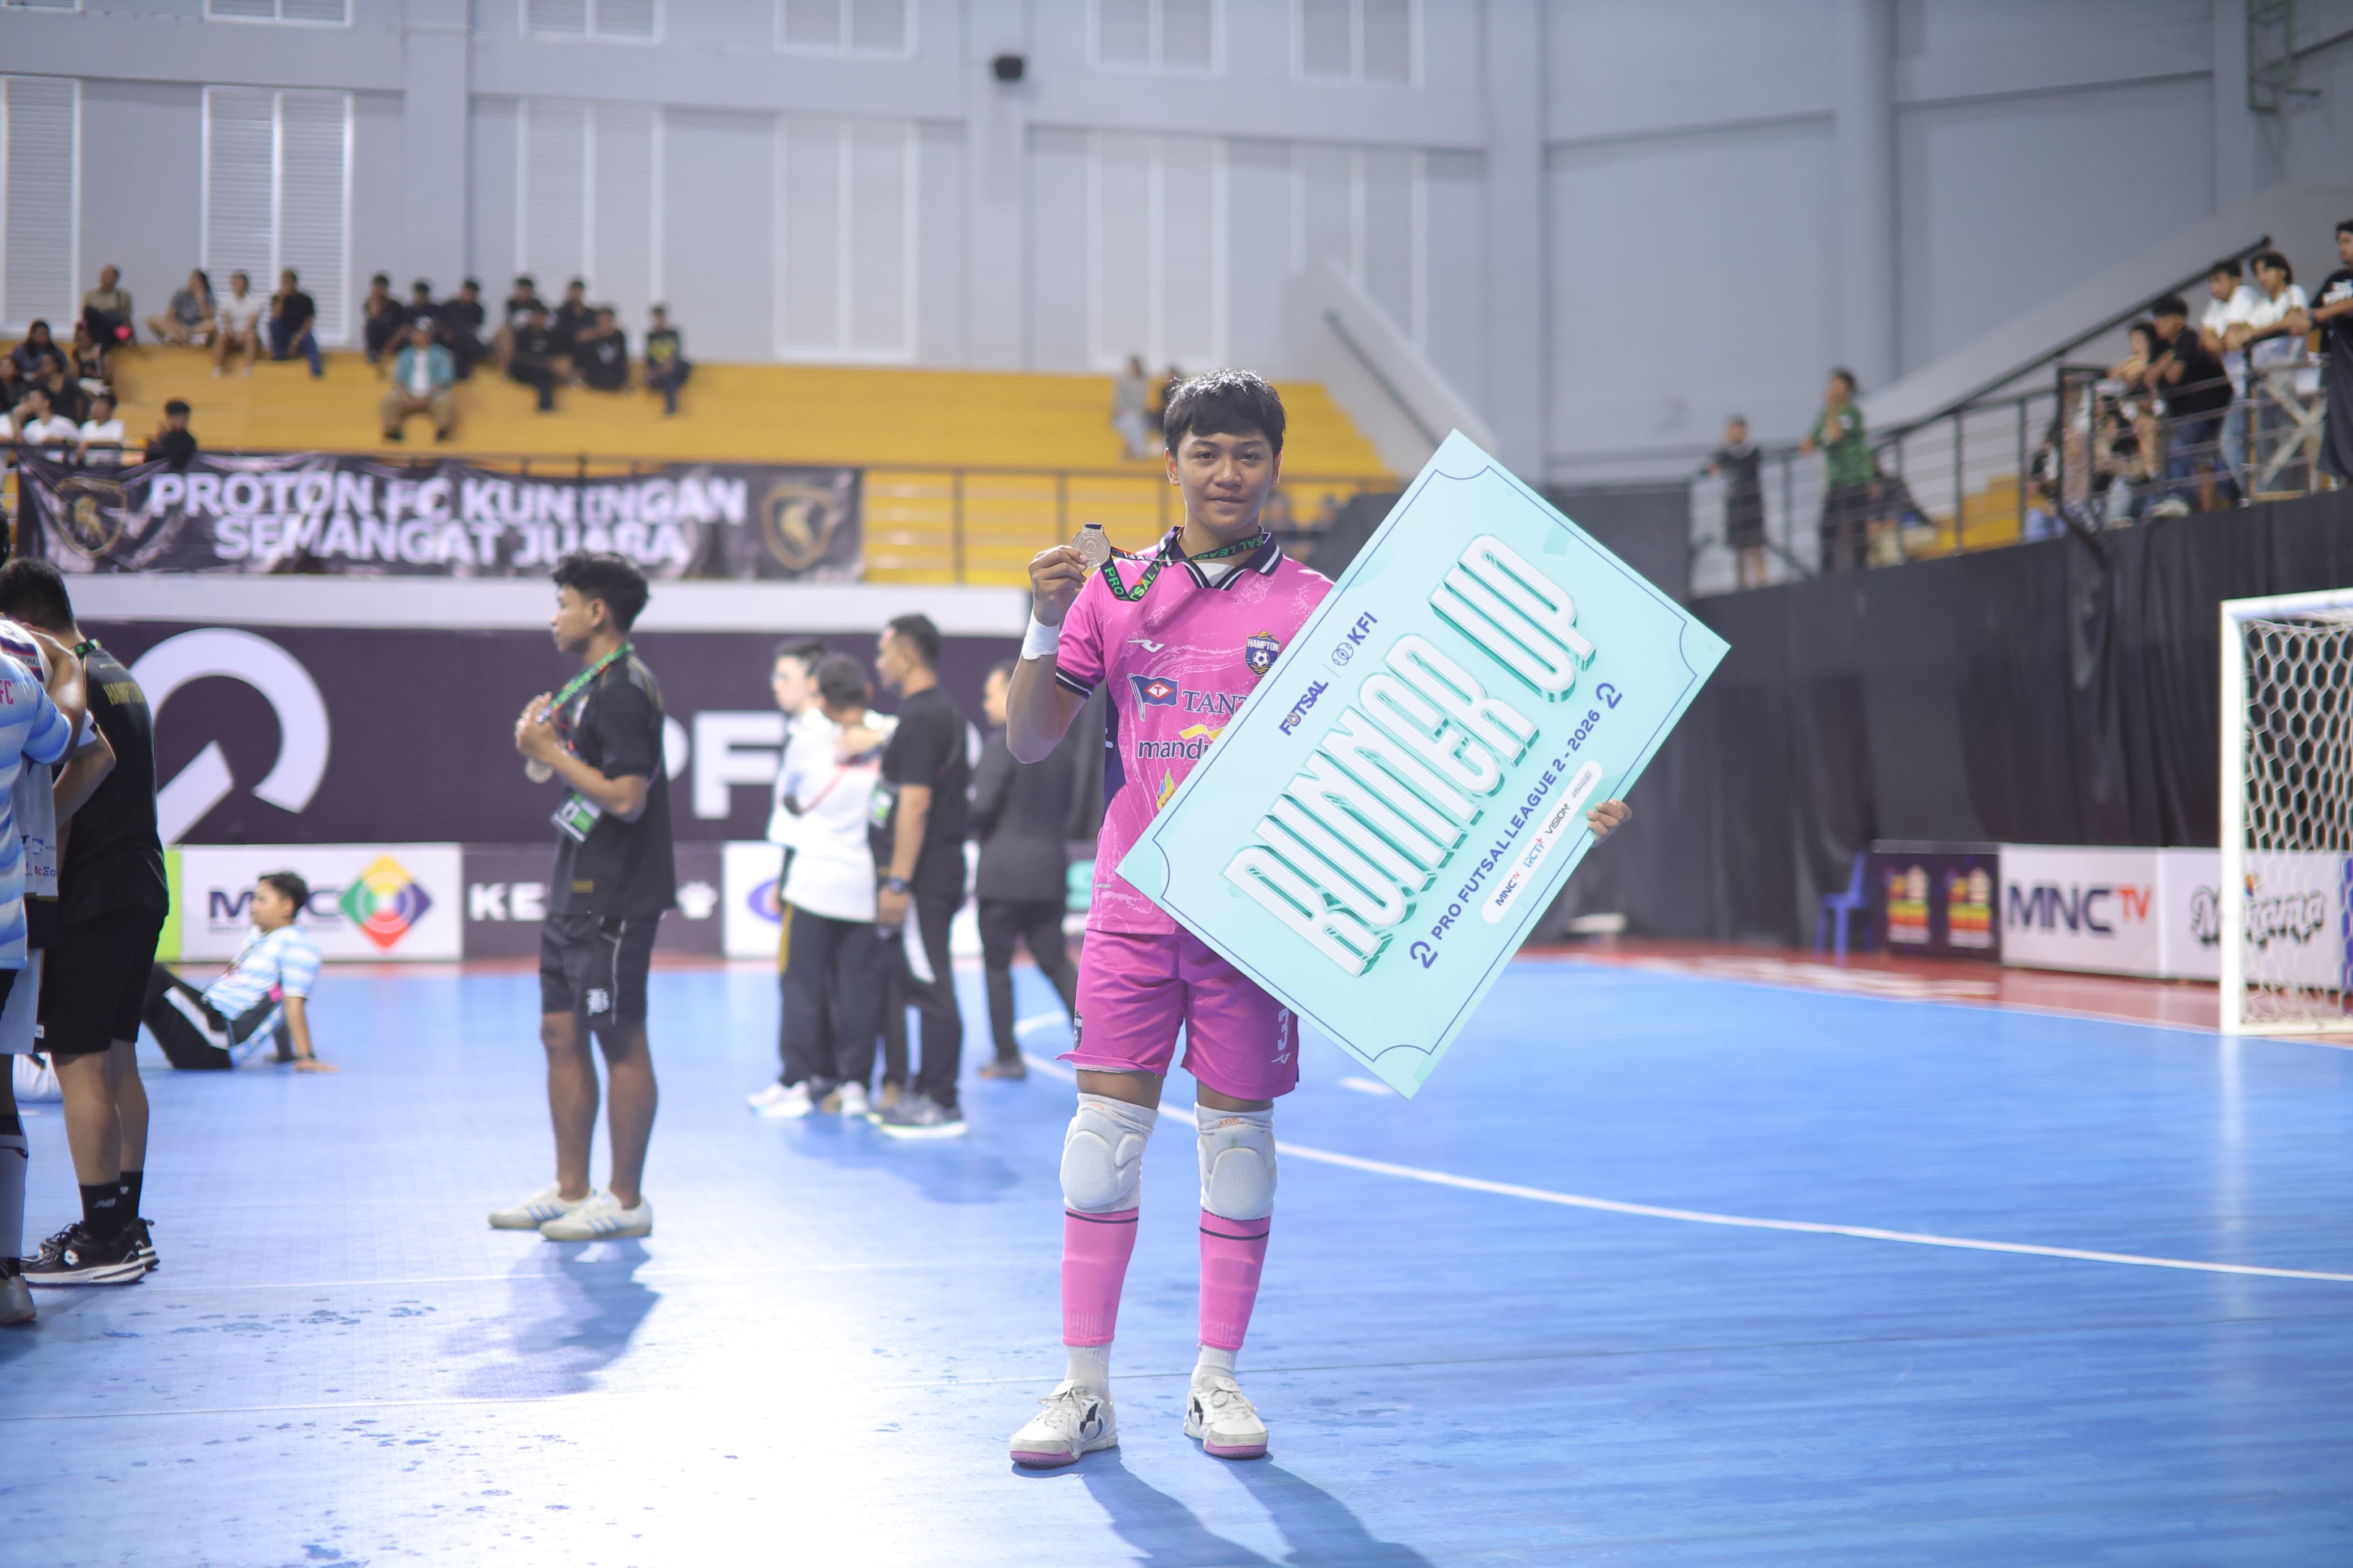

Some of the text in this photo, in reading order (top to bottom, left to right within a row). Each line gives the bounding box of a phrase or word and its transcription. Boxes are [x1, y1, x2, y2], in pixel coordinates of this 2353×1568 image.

[150, 470, 373, 518] PROTON
[385, 477, 455, 522] FC
[214, 515, 504, 566] SEMANGAT
[1104, 567, 1124, 595] PRO
[1247, 638, 1279, 653] HAMPTON
[1279, 611, 1378, 736] FUTSAL KFI
[1222, 533, 1597, 978] RUNNER UP
[1431, 903, 1462, 940] PRO
[1458, 833, 1510, 904] FUTSAL
[1504, 771, 1557, 839] LEAGUE
[1552, 758, 1566, 774] 2
[1568, 709, 1600, 751] 2026
[209, 891, 343, 918] MC
